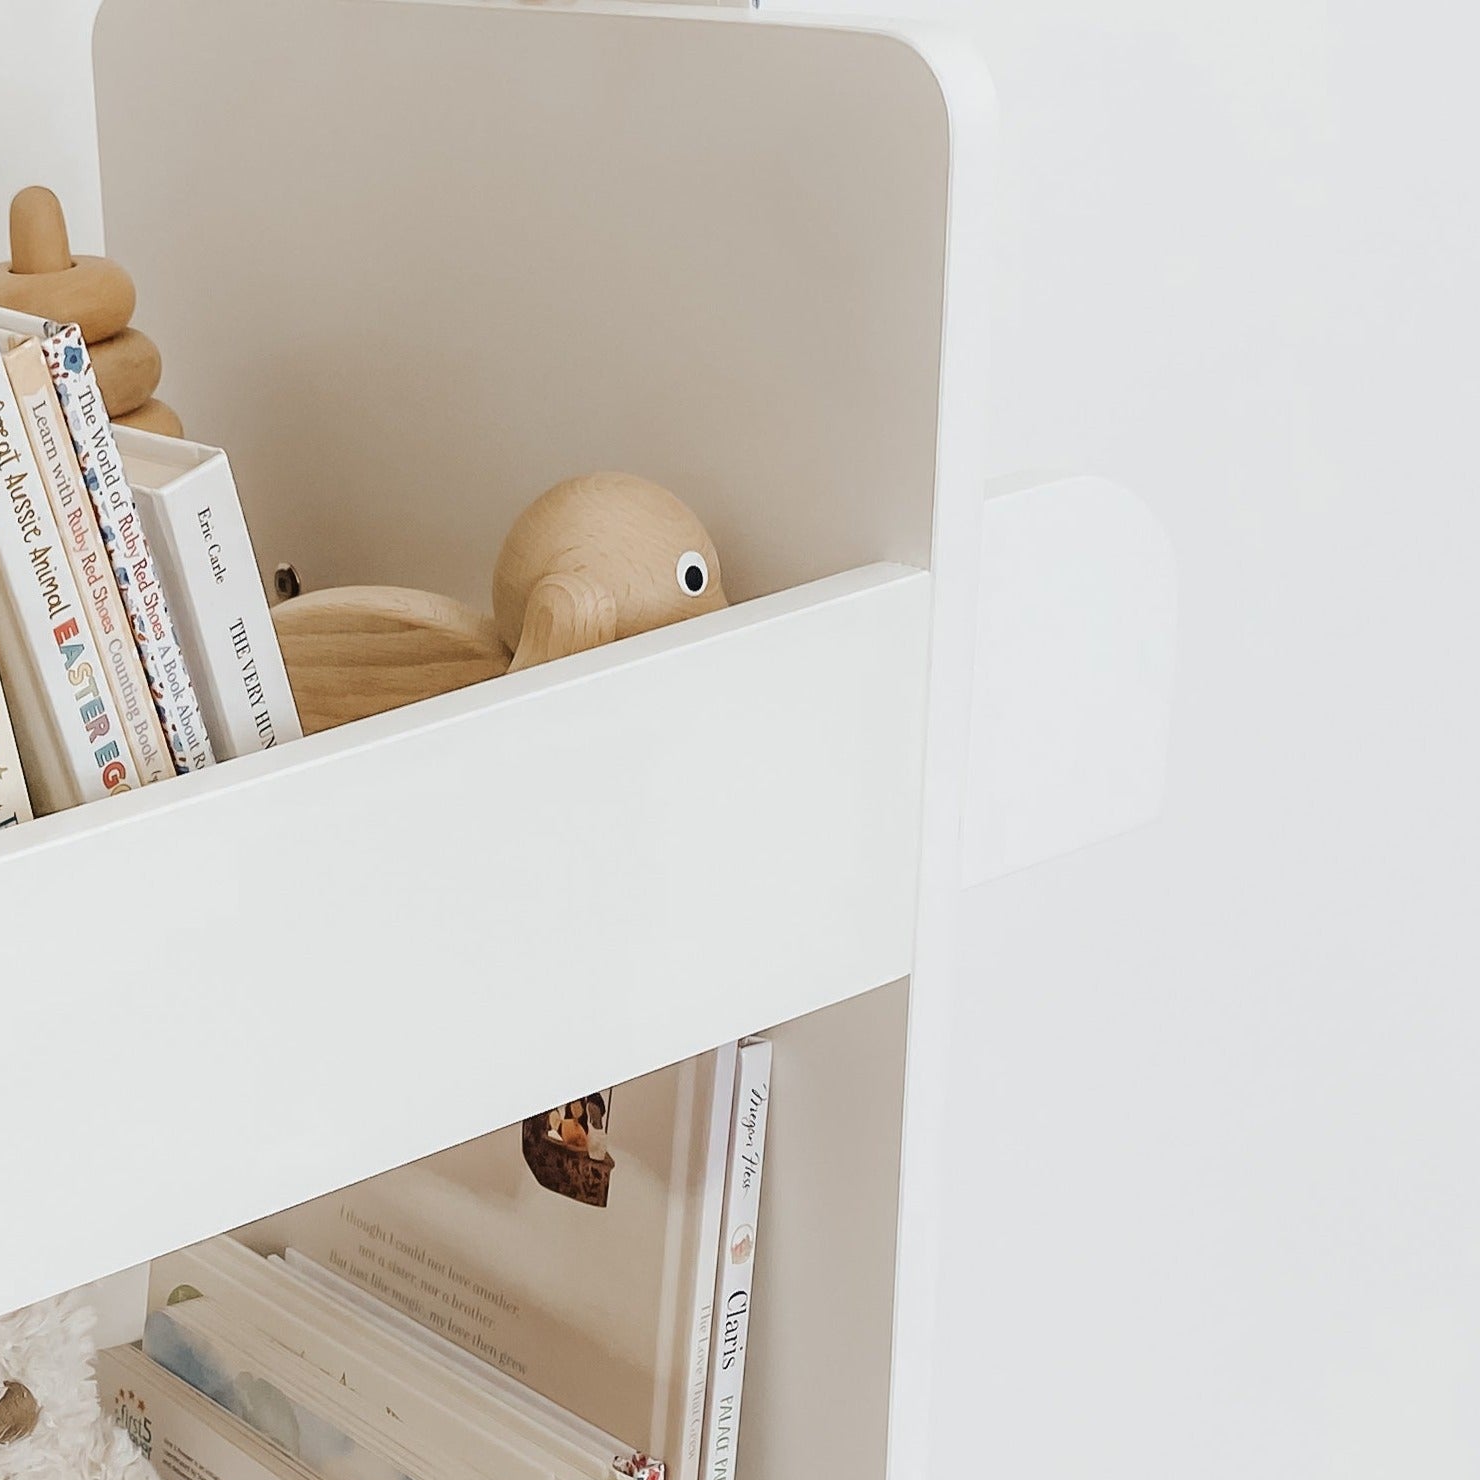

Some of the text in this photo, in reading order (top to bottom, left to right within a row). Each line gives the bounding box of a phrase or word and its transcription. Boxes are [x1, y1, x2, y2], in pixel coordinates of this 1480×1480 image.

[78, 385, 97, 428] The
[32, 400, 58, 461] Learn
[90, 427, 120, 489] World
[52, 462, 75, 508] with
[110, 491, 129, 511] of
[4, 472, 42, 544] Aussie
[29, 546, 72, 620] Animal
[67, 507, 90, 553] Ruby
[118, 513, 140, 559] Ruby
[197, 506, 228, 586] Eric Carle
[81, 551, 104, 587] Red
[132, 557, 155, 593] Red
[92, 586, 116, 635] Shoes
[143, 592, 166, 641] Shoes
[158, 644, 172, 660] A
[229, 616, 252, 660] THE
[241, 657, 266, 713] VERY
[53, 617, 111, 744] EASTER
[108, 638, 141, 722] Counting
[163, 658, 185, 702] Book
[134, 717, 157, 766] Book
[177, 704, 201, 750] About
[345, 1209, 386, 1242] thought
[395, 1239, 426, 1265] could
[427, 1257, 446, 1275] not
[448, 1265, 471, 1288] love
[359, 1243, 376, 1263] not
[447, 1317, 471, 1340] love
[472, 1333, 498, 1360] then
[722, 1289, 749, 1371] Claris
[694, 1336, 709, 1376] Love
[715, 1394, 735, 1453] PALACE
